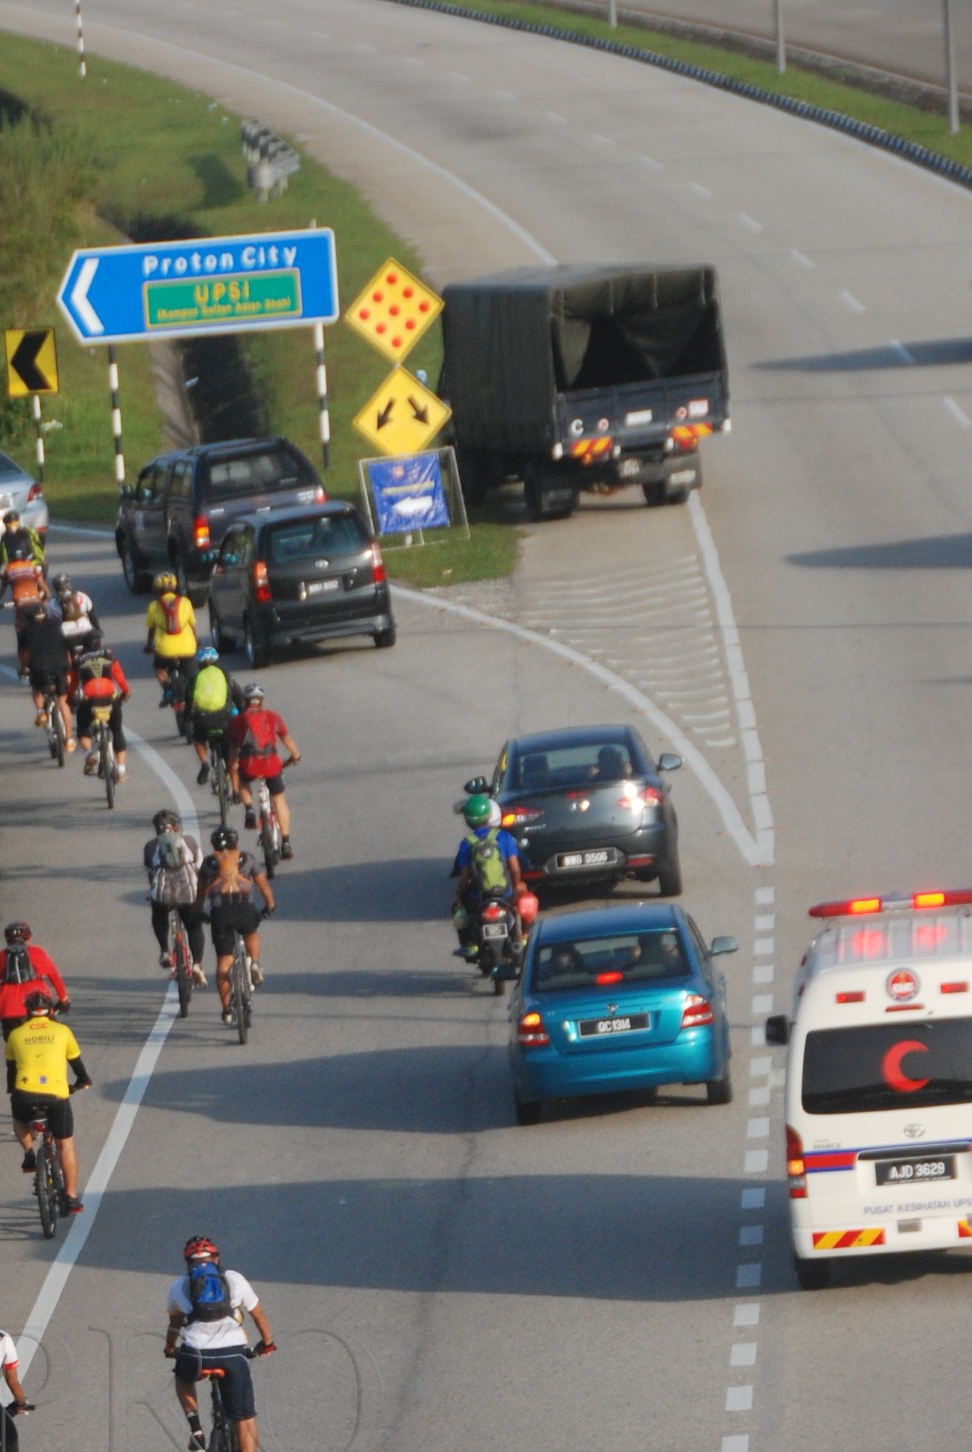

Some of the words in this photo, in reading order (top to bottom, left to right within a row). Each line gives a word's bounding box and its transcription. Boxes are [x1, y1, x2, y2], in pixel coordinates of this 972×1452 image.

[142, 252, 234, 277] Proton
[241, 245, 298, 267] City
[194, 281, 250, 305] UPSI
[890, 1164, 914, 1180] AJD
[914, 1161, 946, 1177] 3629
[864, 1204, 893, 1215] PUSAT
[897, 1199, 950, 1213] KESIHATAN
